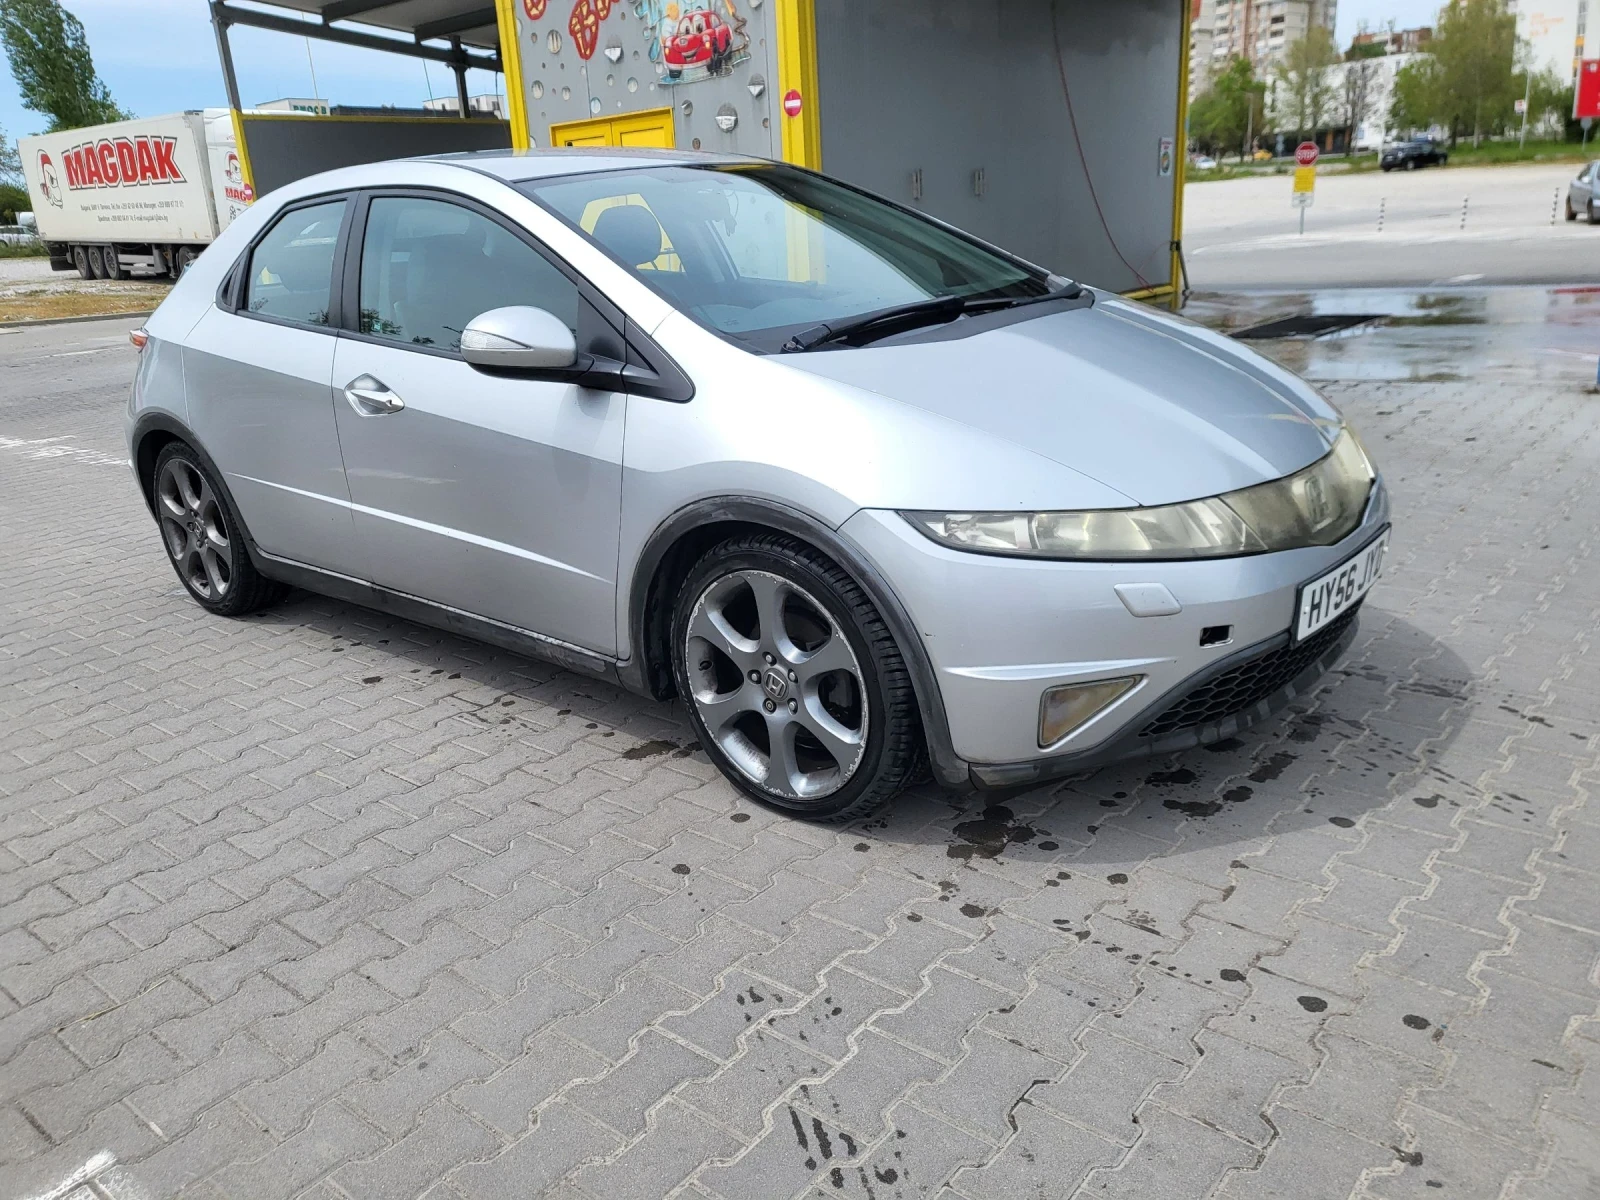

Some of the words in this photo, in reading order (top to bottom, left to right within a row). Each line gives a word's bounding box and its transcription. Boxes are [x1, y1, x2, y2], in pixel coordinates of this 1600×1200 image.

[62, 137, 186, 189] MAGDAK
[225, 187, 248, 203] MAG
[1308, 563, 1357, 629] HY56
